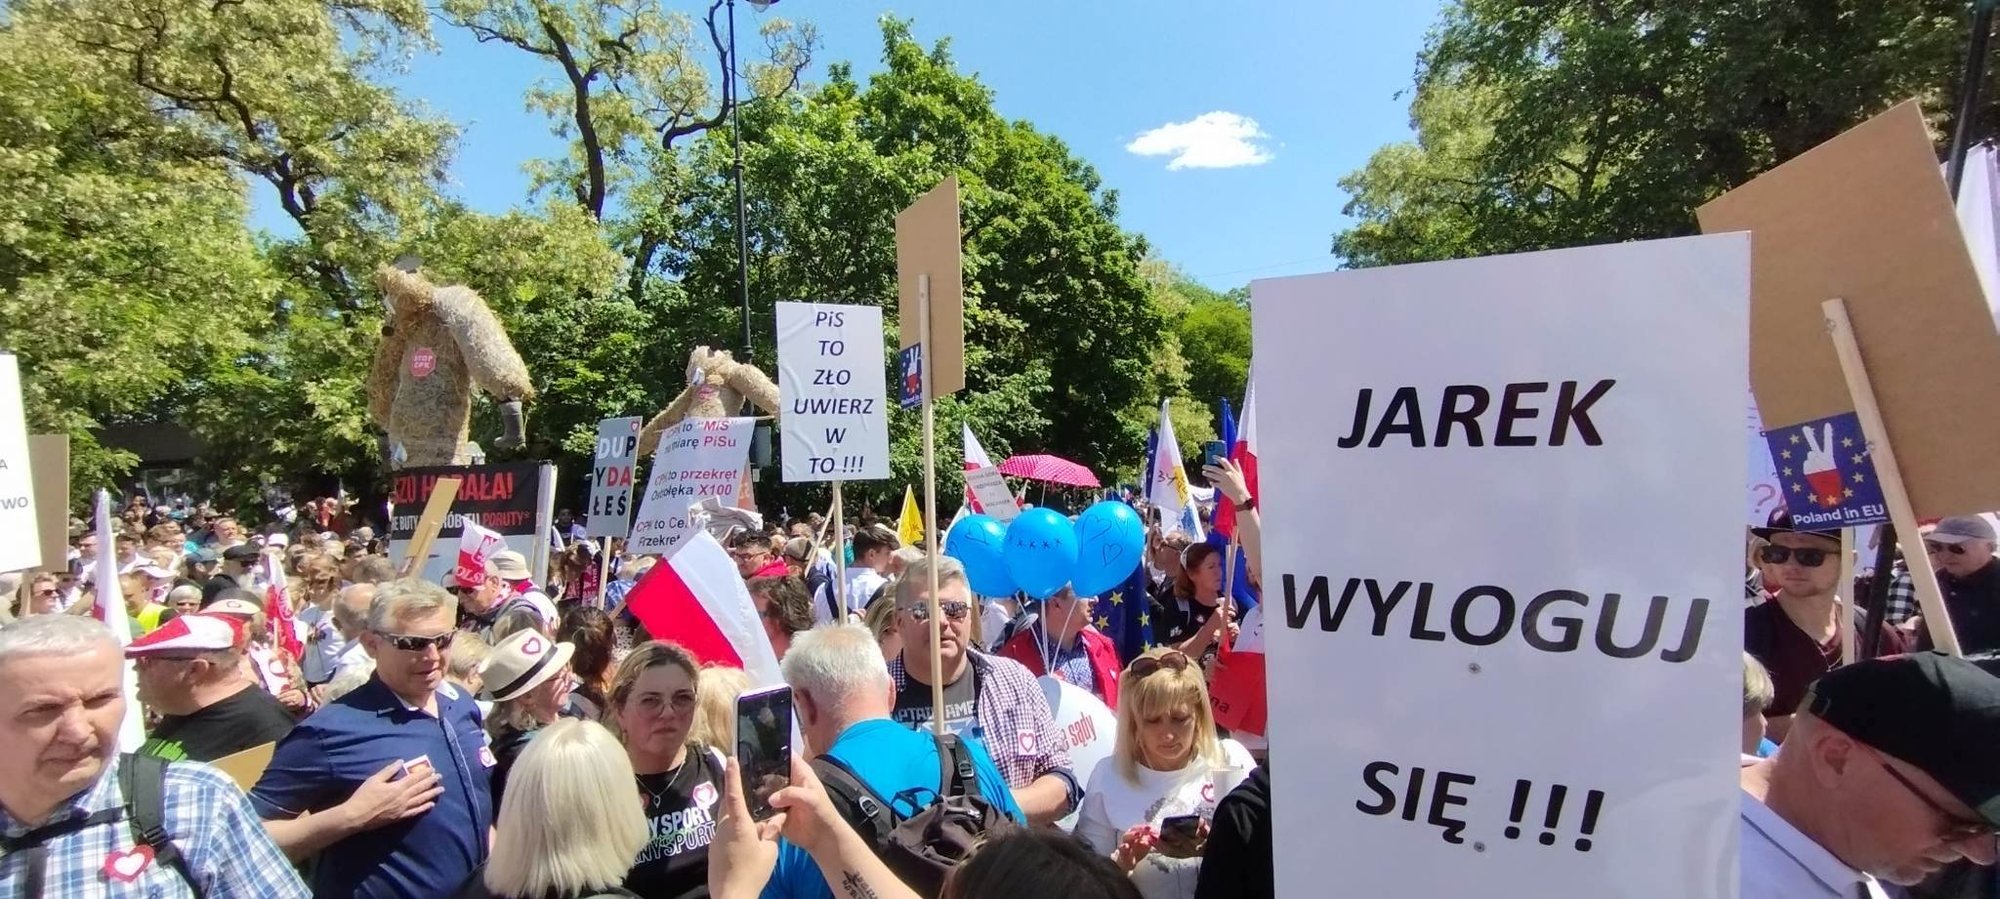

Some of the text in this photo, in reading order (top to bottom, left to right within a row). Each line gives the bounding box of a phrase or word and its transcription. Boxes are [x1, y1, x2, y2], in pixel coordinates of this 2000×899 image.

[815, 311, 844, 327] PiS
[818, 340, 844, 356] TO
[813, 369, 851, 386] ZŁO
[793, 399, 874, 415] UWIERZ
[1337, 379, 1617, 449] JAREK
[703, 435, 737, 448] PiSu
[825, 428, 847, 444] W
[597, 436, 637, 460] DUP
[808, 456, 865, 475] TO !!!
[594, 466, 632, 488] YDA
[680, 468, 738, 483] przekręt
[422, 471, 514, 503] HRAŁA!
[698, 484, 733, 496] X100
[592, 490, 627, 517] ŁEŚ
[668, 516, 688, 529] Ce
[1792, 508, 1841, 525] Poland
[1843, 507, 1860, 520] in
[1861, 504, 1885, 517] EU
[1281, 573, 1710, 664] WYLOGUJ
[1355, 760, 1605, 852] SIĘ !!!
